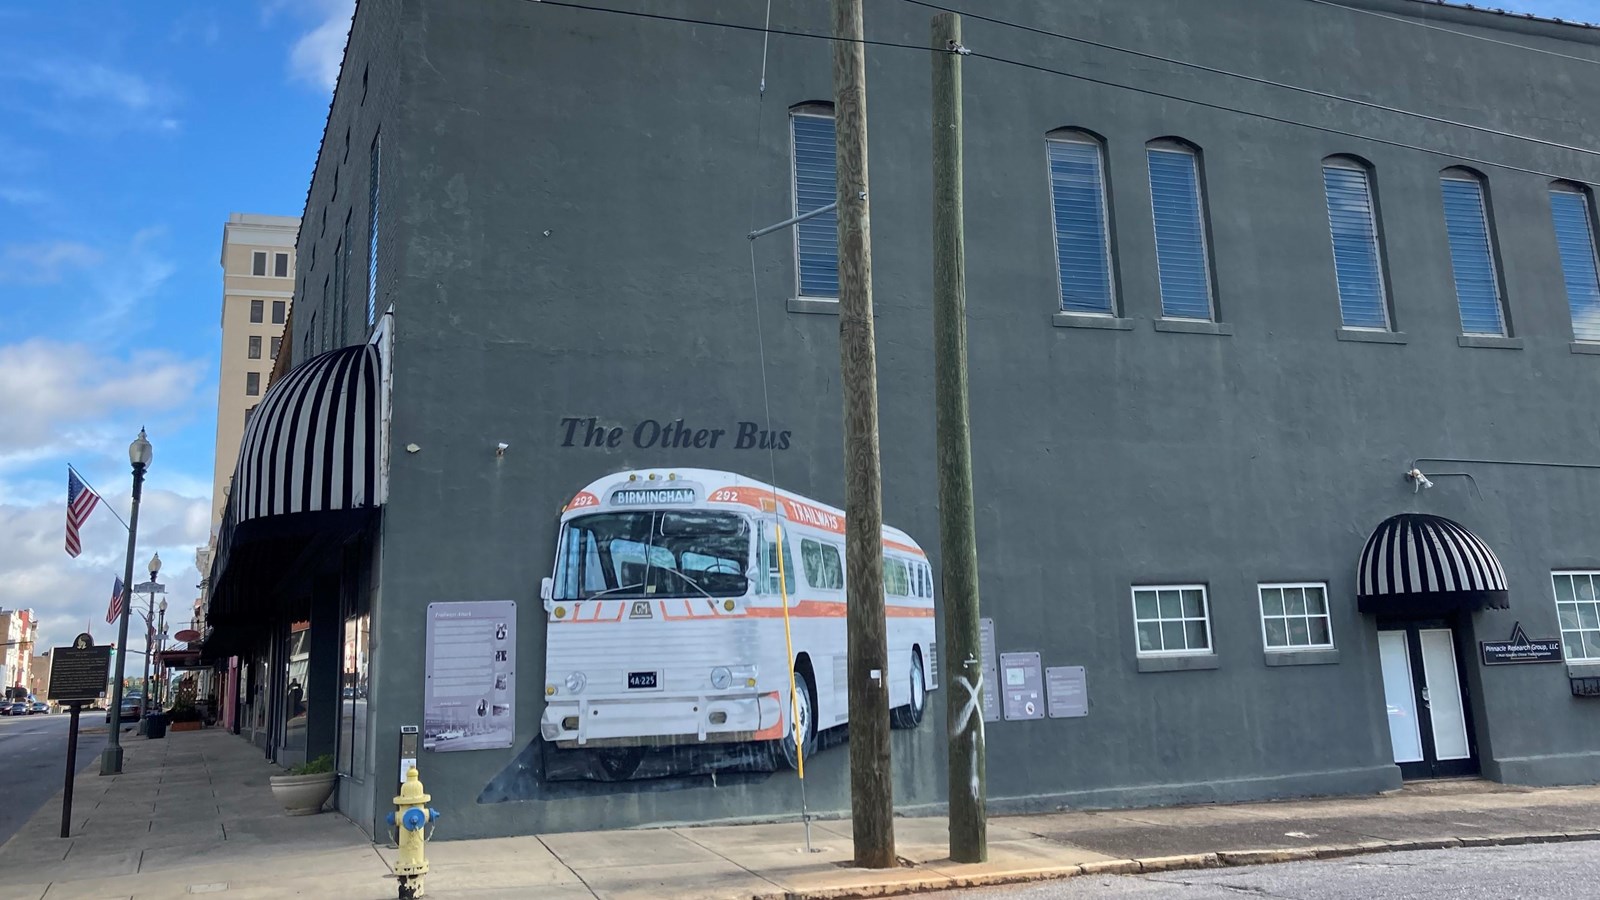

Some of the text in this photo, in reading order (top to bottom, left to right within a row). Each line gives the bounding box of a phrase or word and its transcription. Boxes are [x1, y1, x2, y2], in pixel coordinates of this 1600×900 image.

[560, 417, 792, 450] The Other Bus
[574, 495, 593, 506] 292
[617, 490, 695, 504] BIRMINGHAM
[715, 490, 739, 501] 292
[789, 501, 838, 530] TRAILWAYS
